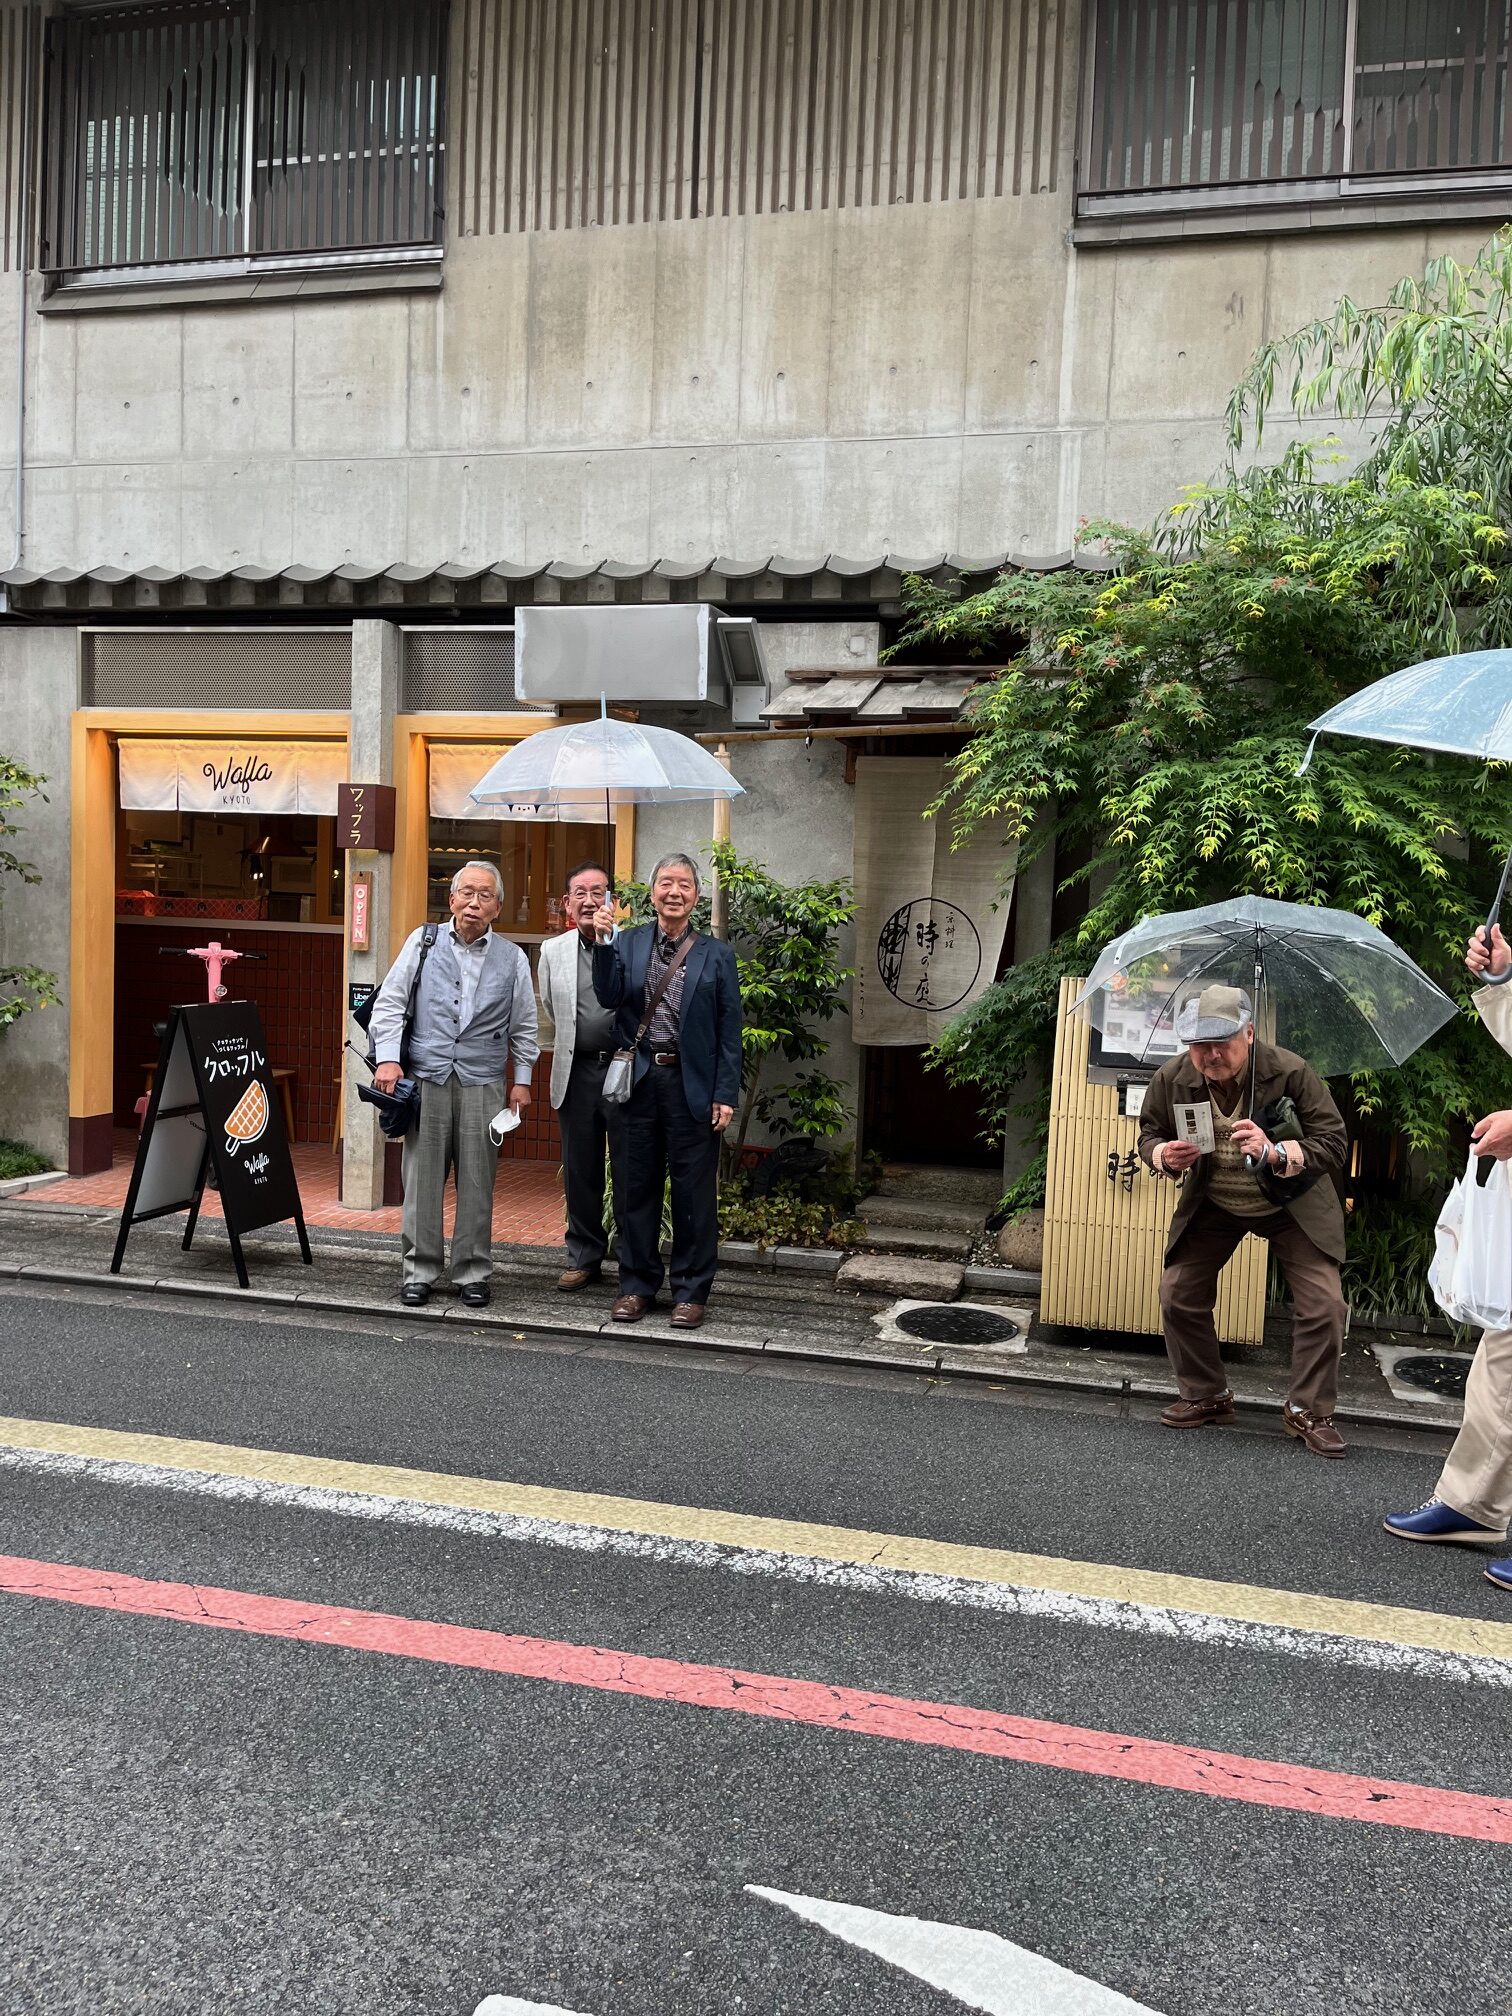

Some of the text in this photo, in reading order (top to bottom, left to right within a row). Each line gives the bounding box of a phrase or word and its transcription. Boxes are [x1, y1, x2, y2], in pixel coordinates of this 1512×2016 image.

[202, 755, 273, 794] Wafla
[222, 795, 251, 805] KYOTO
[349, 787, 364, 845] ワッフラ
[354, 888, 365, 939] OPEN
[945, 911, 956, 949] 京料理
[914, 919, 940, 1006] 時の庭
[353, 999, 366, 1007] Ea
[204, 1050, 265, 1082] クロッフル
[244, 1152, 270, 1174] Wafla
